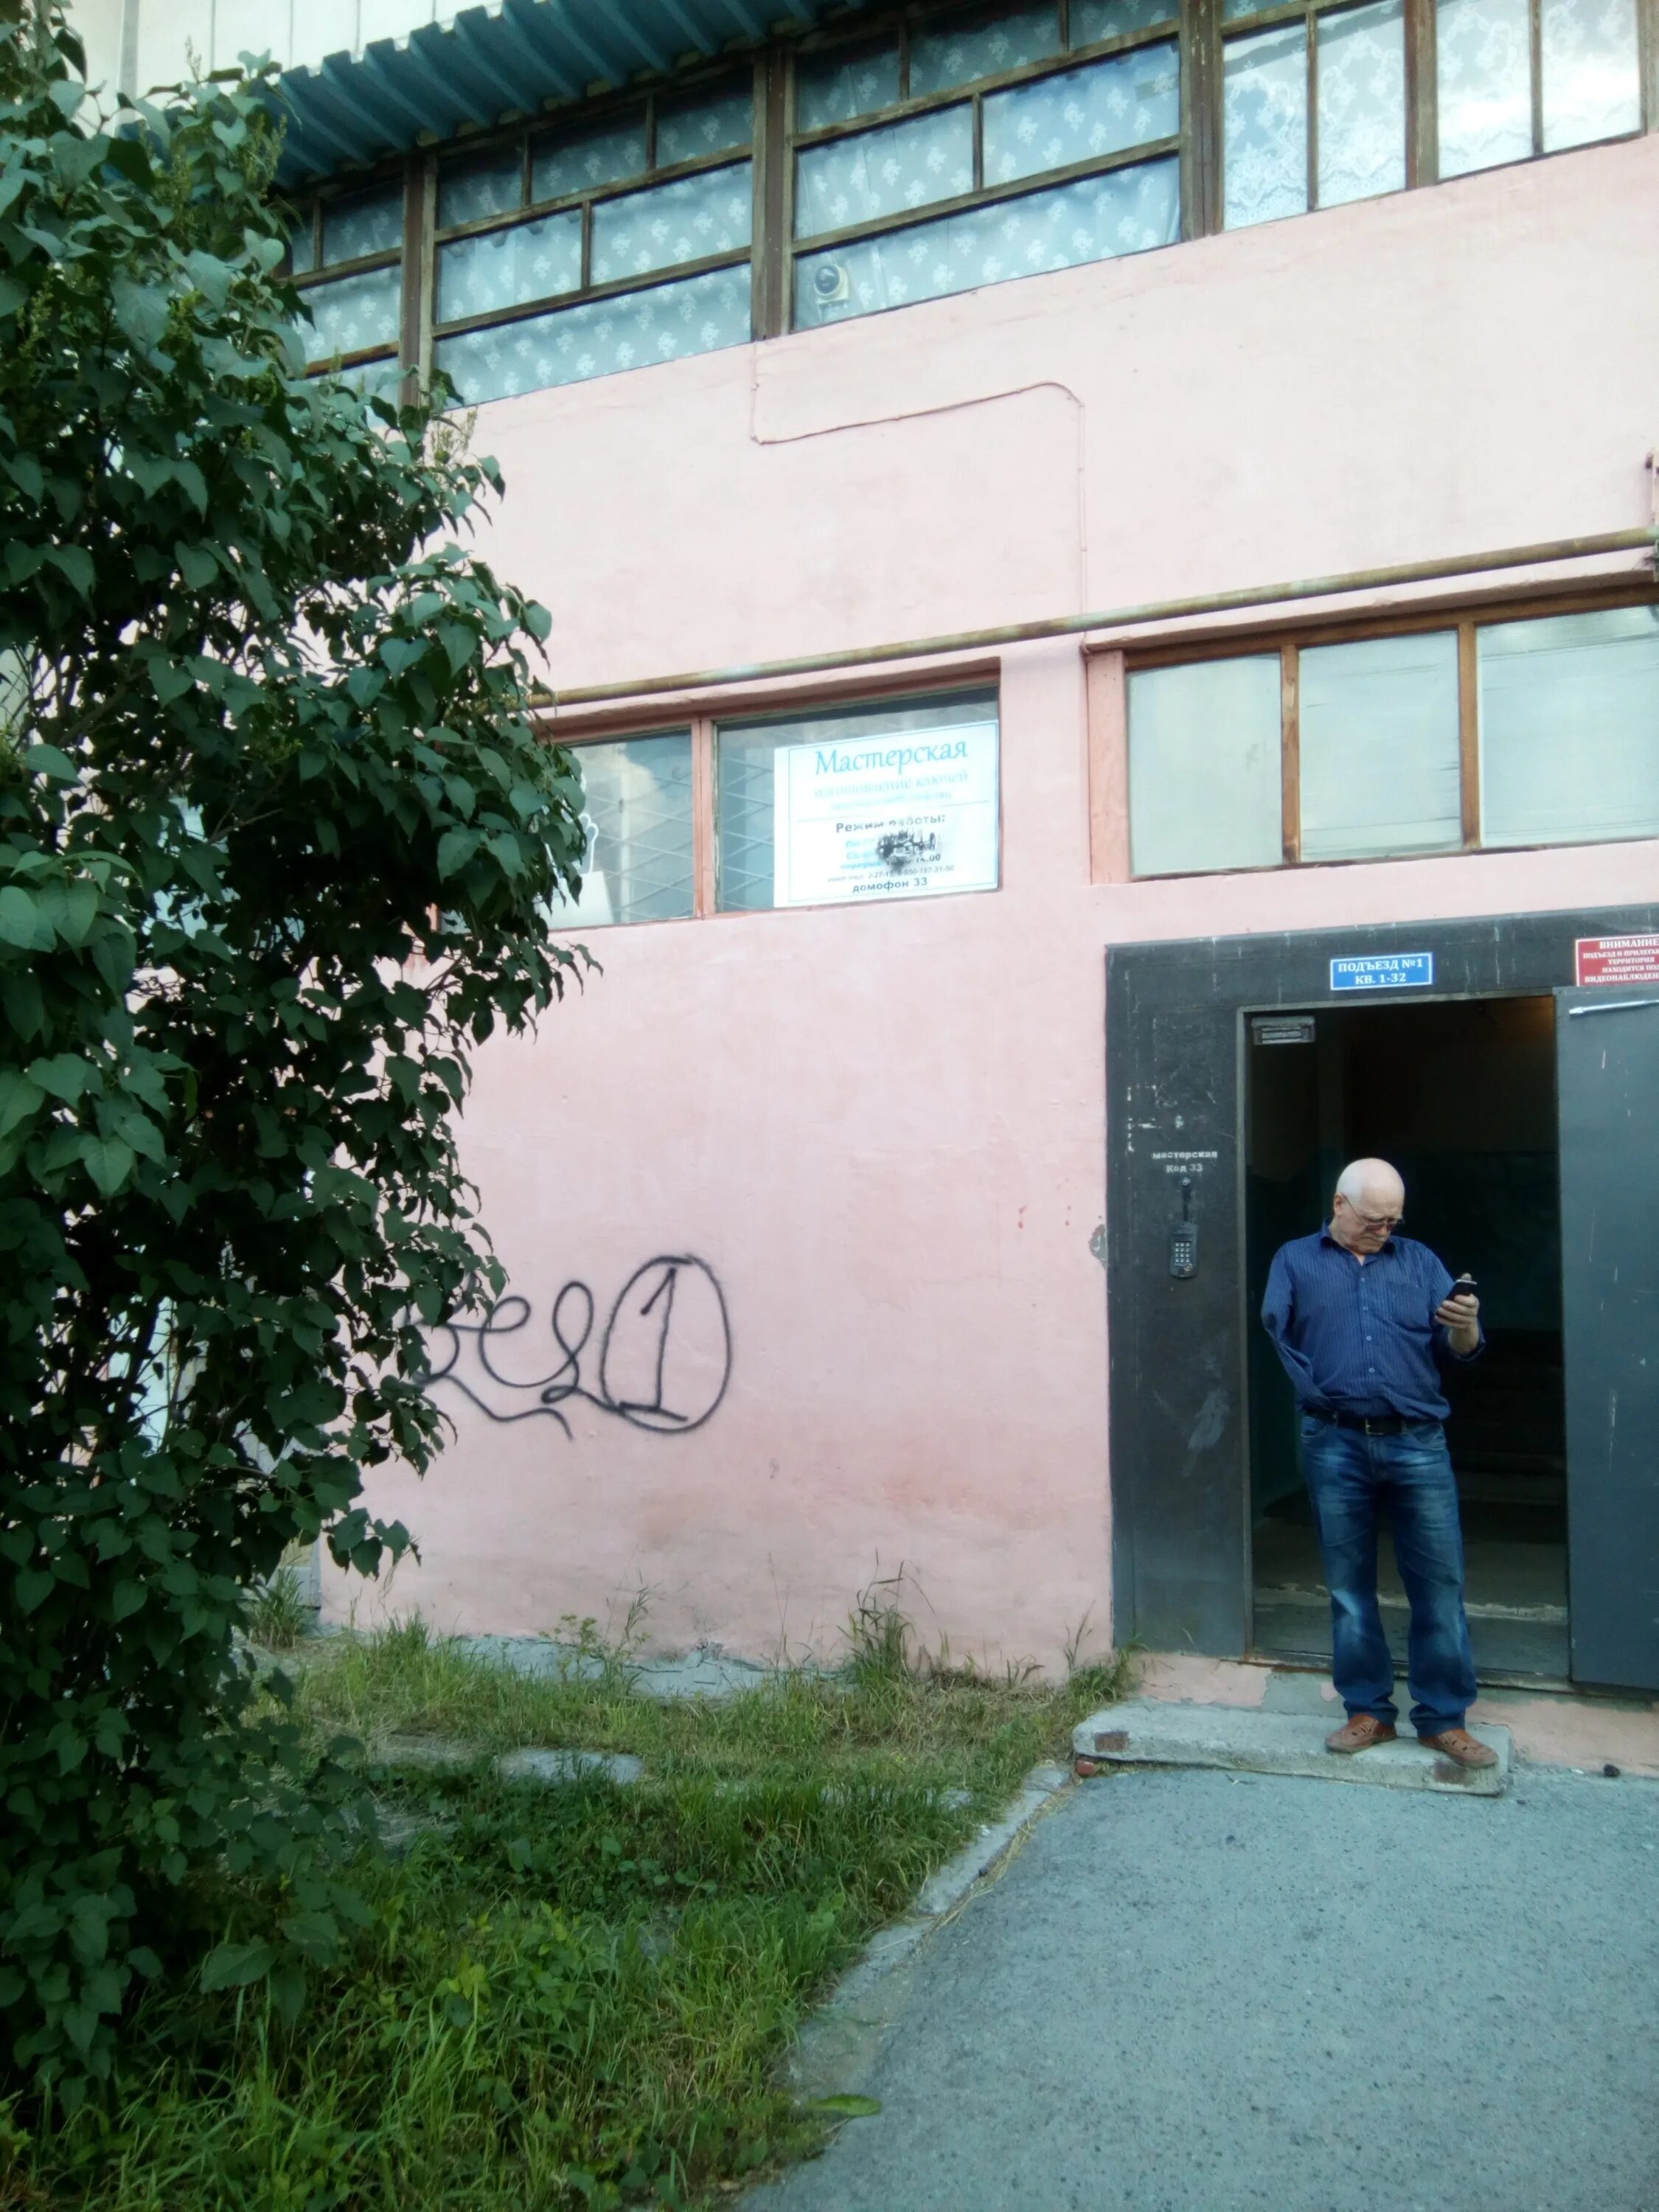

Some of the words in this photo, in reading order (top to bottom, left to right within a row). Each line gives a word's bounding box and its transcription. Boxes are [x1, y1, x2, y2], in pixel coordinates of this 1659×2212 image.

[815, 741, 967, 775] Мастерская
[836, 821, 884, 832] Режим
[852, 880, 909, 894] домофон
[914, 877, 928, 886] 33
[1338, 960, 1399, 973] ПОДЪЕЗД
[1402, 958, 1423, 968] №1
[1355, 974, 1376, 984] КВ.
[1379, 973, 1407, 984] 1-32
[1152, 1151, 1218, 1160] мастерская
[1189, 1163, 1203, 1172] 33
